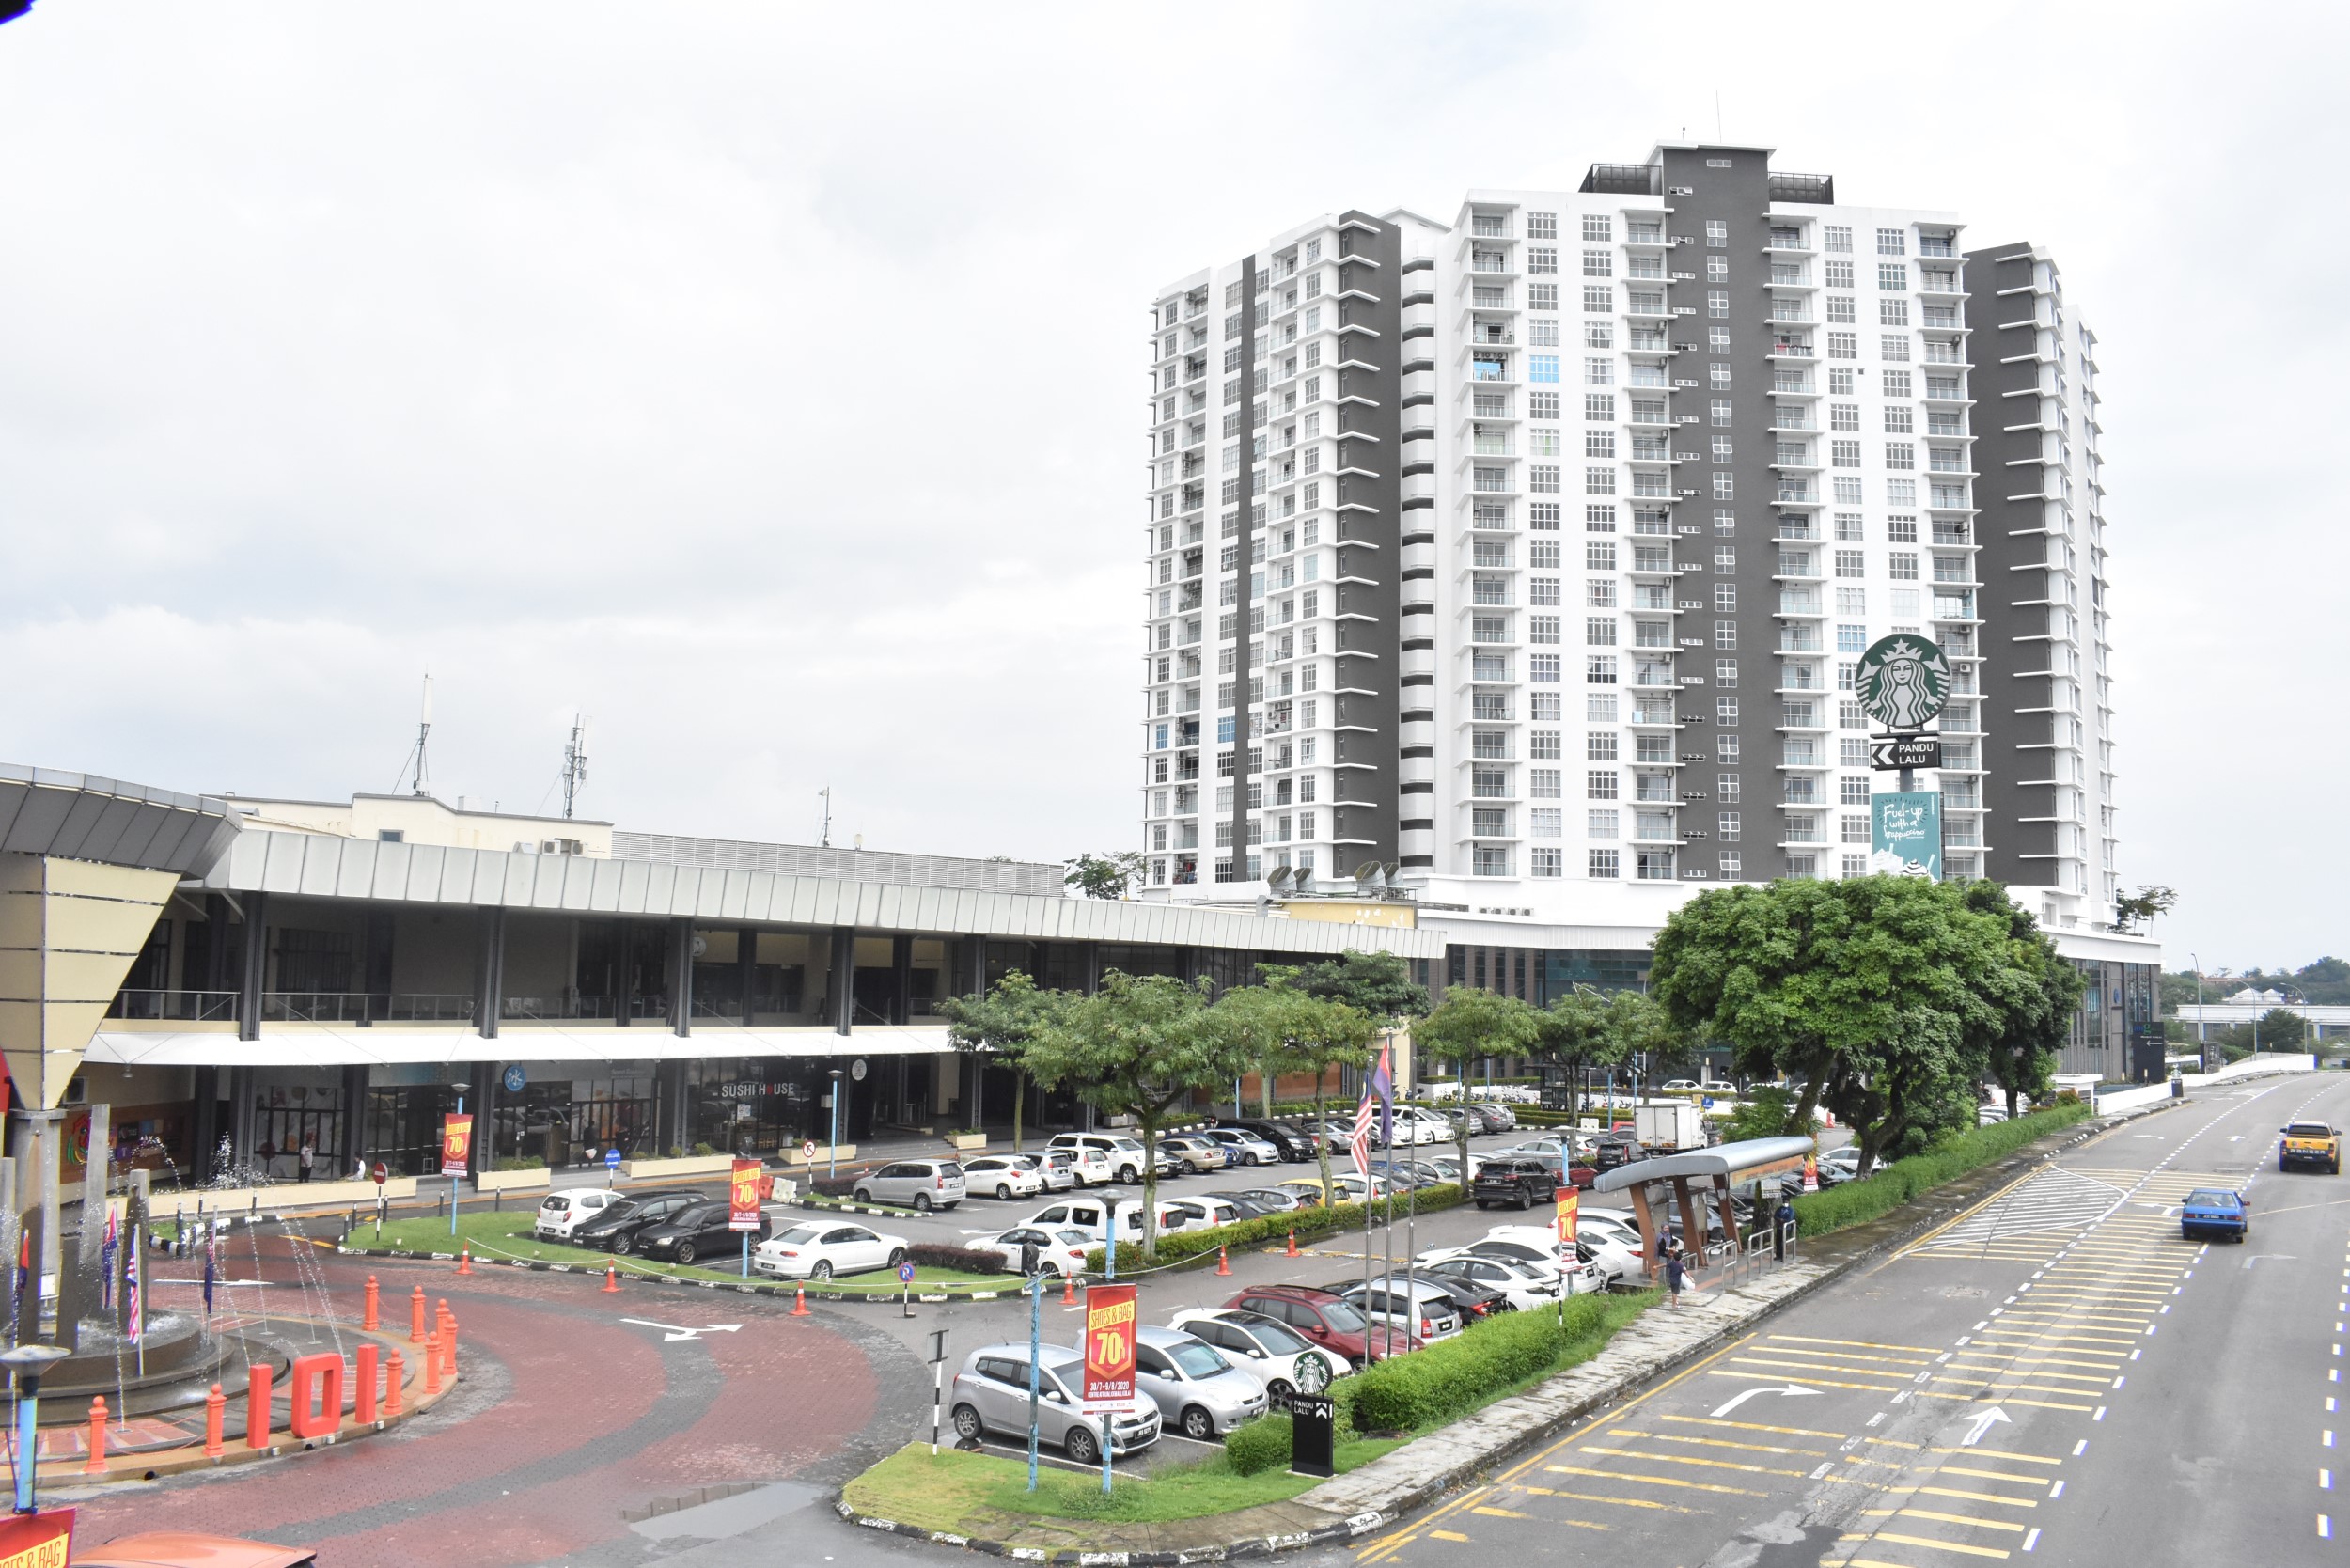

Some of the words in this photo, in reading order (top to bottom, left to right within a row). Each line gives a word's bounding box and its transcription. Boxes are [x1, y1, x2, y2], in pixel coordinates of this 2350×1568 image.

[1899, 743, 1934, 753] PANDU
[1899, 755, 1926, 764] LALU
[1883, 802, 1923, 823] Fuel-up
[1889, 818, 1909, 830] with
[721, 1084, 756, 1098] SUSHI
[759, 1083, 794, 1096] HOUSE
[1090, 1309, 1110, 1328] SHOES
[1111, 1307, 1117, 1323] &
[1119, 1303, 1131, 1321] BAG
[1096, 1331, 1126, 1365] 70%
[1293, 1400, 1314, 1409] PANDU
[1293, 1406, 1309, 1415] LALU
[39, 1541, 62, 1568] BAG
